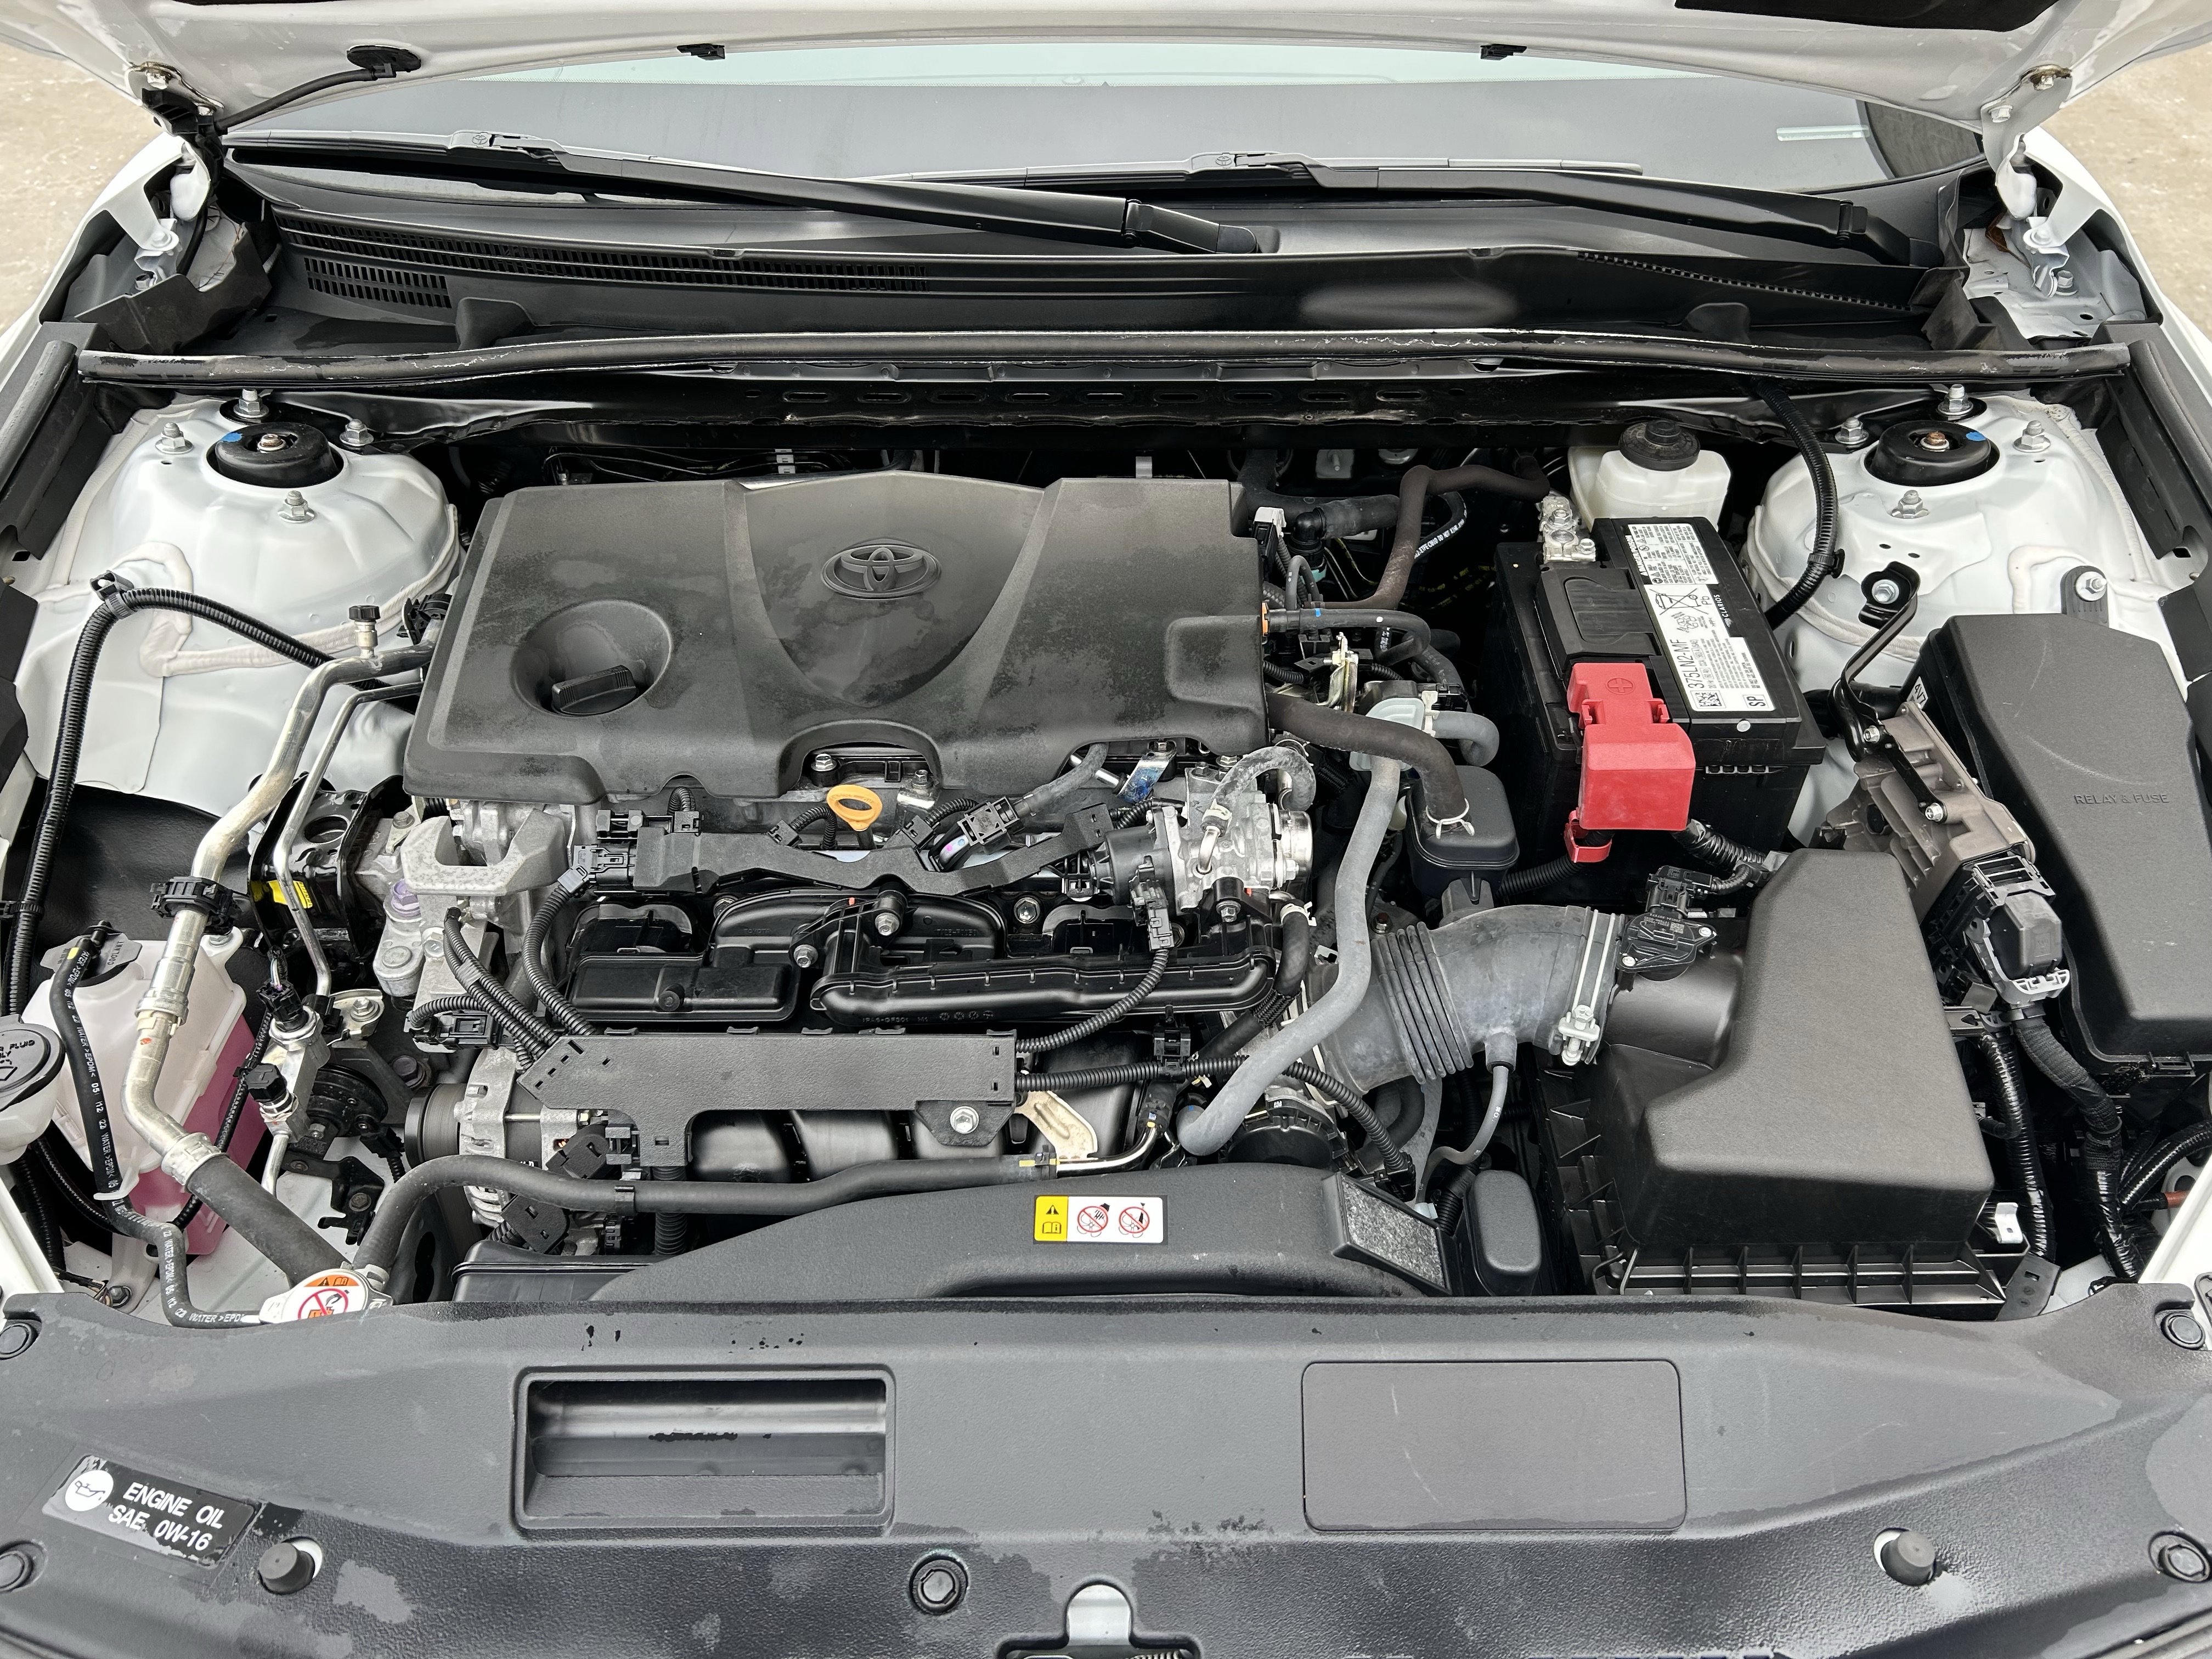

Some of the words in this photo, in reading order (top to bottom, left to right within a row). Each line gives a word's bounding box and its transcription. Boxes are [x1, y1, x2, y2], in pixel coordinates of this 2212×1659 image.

[1625, 535, 1647, 572] DANGER/POISON
[1700, 596, 1712, 605] Pb
[1714, 594, 1728, 617] CLARIOS
[1669, 639, 1705, 689] 375LN2-MF
[1746, 696, 1766, 707] SP
[1915, 683, 1926, 704] 4V7
[2074, 794, 2117, 804] RELAY
[2121, 795, 2130, 804] &
[2134, 793, 2171, 803] FUSE
[107, 941, 125, 966] COOLANT
[9, 1040, 35, 1050] FLUID
[77, 1026, 89, 1047] WATER
[100, 1132, 111, 1155] WATER
[164, 1238, 174, 1260] WATER
[189, 1313, 218, 1323] WATER
[123, 1481, 193, 1516] ENGINE
[195, 1505, 227, 1530] OIL
[108, 1504, 150, 1531] SAE
[154, 1519, 213, 1551] 0W-16
